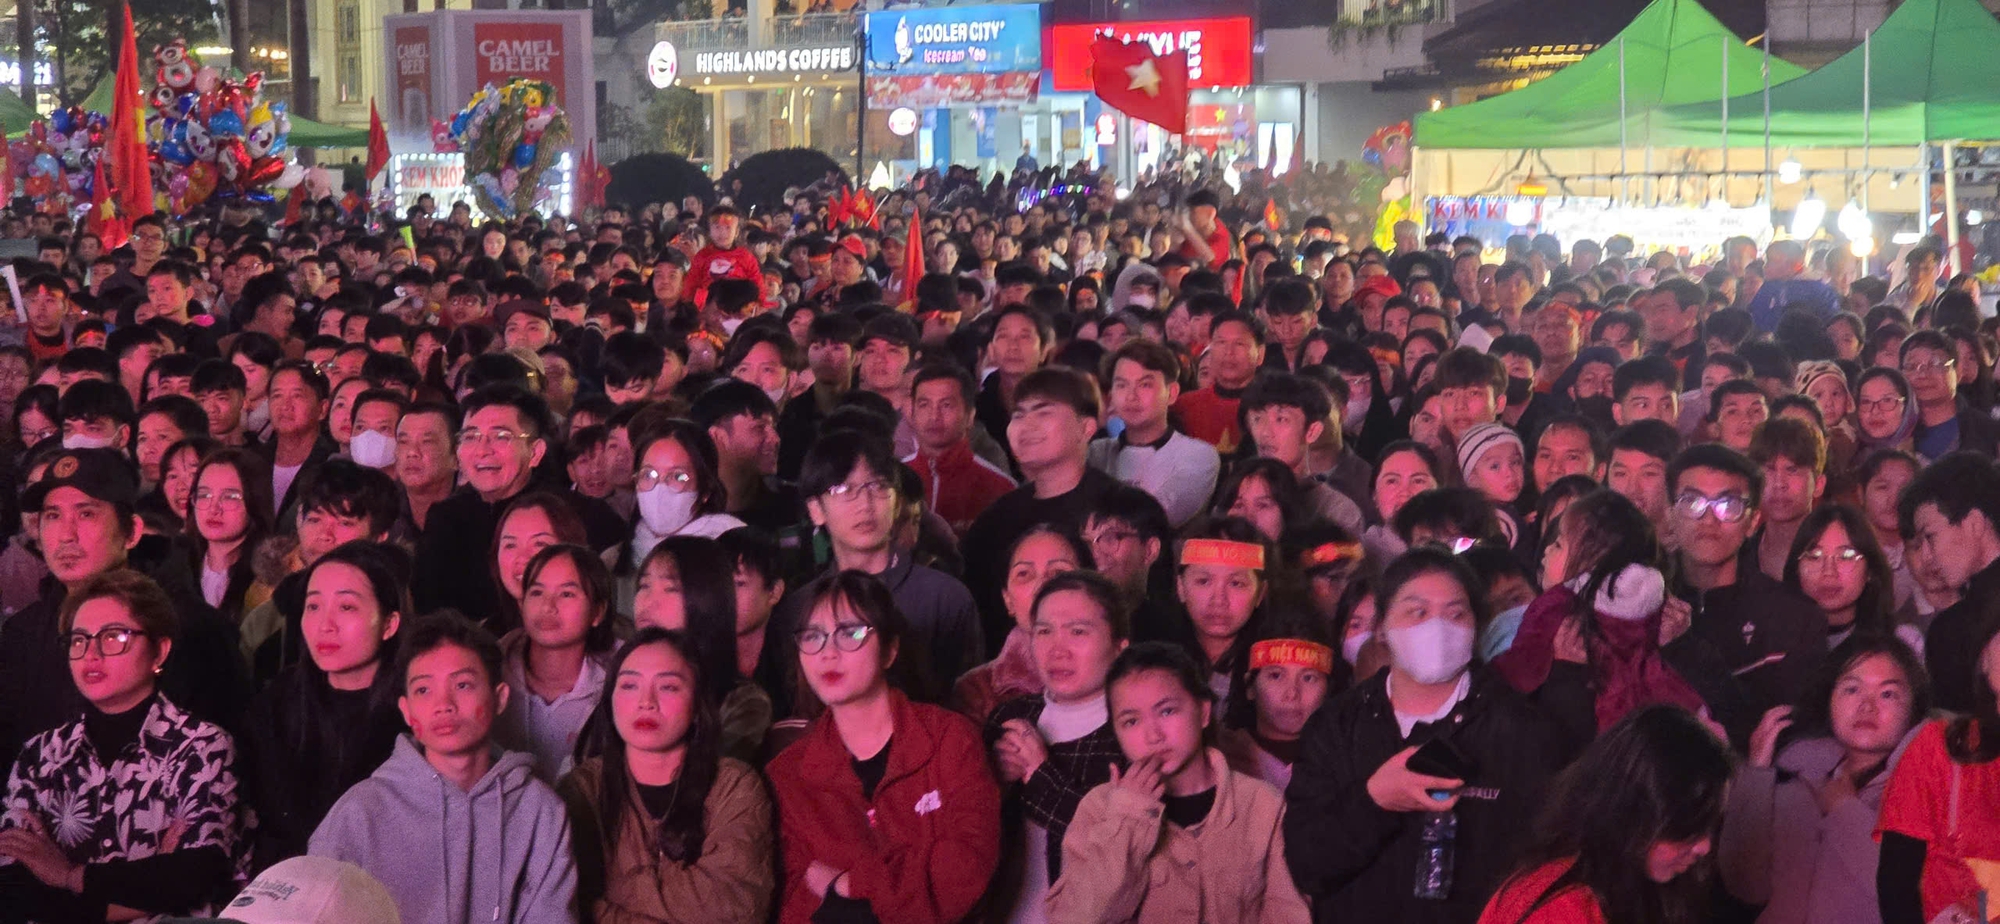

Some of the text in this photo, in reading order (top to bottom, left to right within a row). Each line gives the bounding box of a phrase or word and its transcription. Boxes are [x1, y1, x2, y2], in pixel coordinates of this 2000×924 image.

[914, 20, 1001, 44] COOLER CITY
[397, 43, 429, 59] CAMEL
[478, 40, 560, 56] CAMEL
[401, 58, 425, 75] BEER
[490, 56, 550, 72] BEER
[696, 50, 787, 73] HIGHLANDS
[400, 164, 427, 189] KEM
